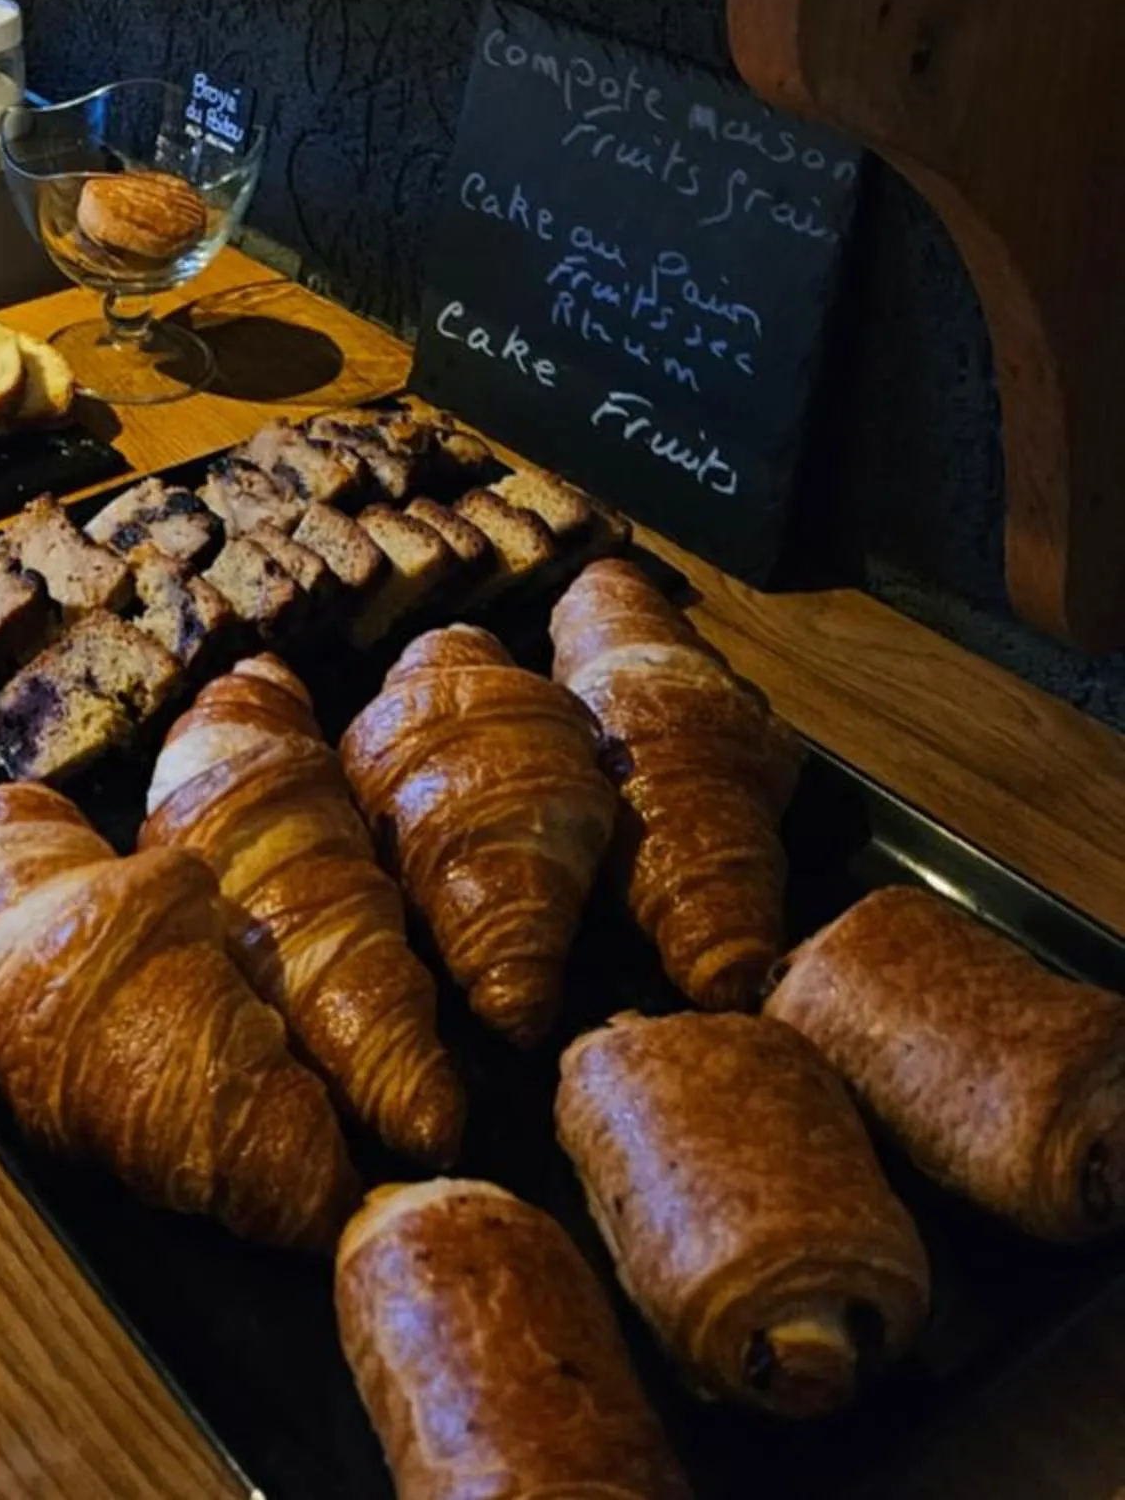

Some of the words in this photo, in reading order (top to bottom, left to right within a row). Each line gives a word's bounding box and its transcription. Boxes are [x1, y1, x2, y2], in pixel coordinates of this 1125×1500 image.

[483, 28, 667, 120] Compote
[561, 103, 701, 196] Fruits
[460, 171, 555, 242] Cake
[436, 300, 560, 389] Cake
[590, 390, 739, 496] Fruits
